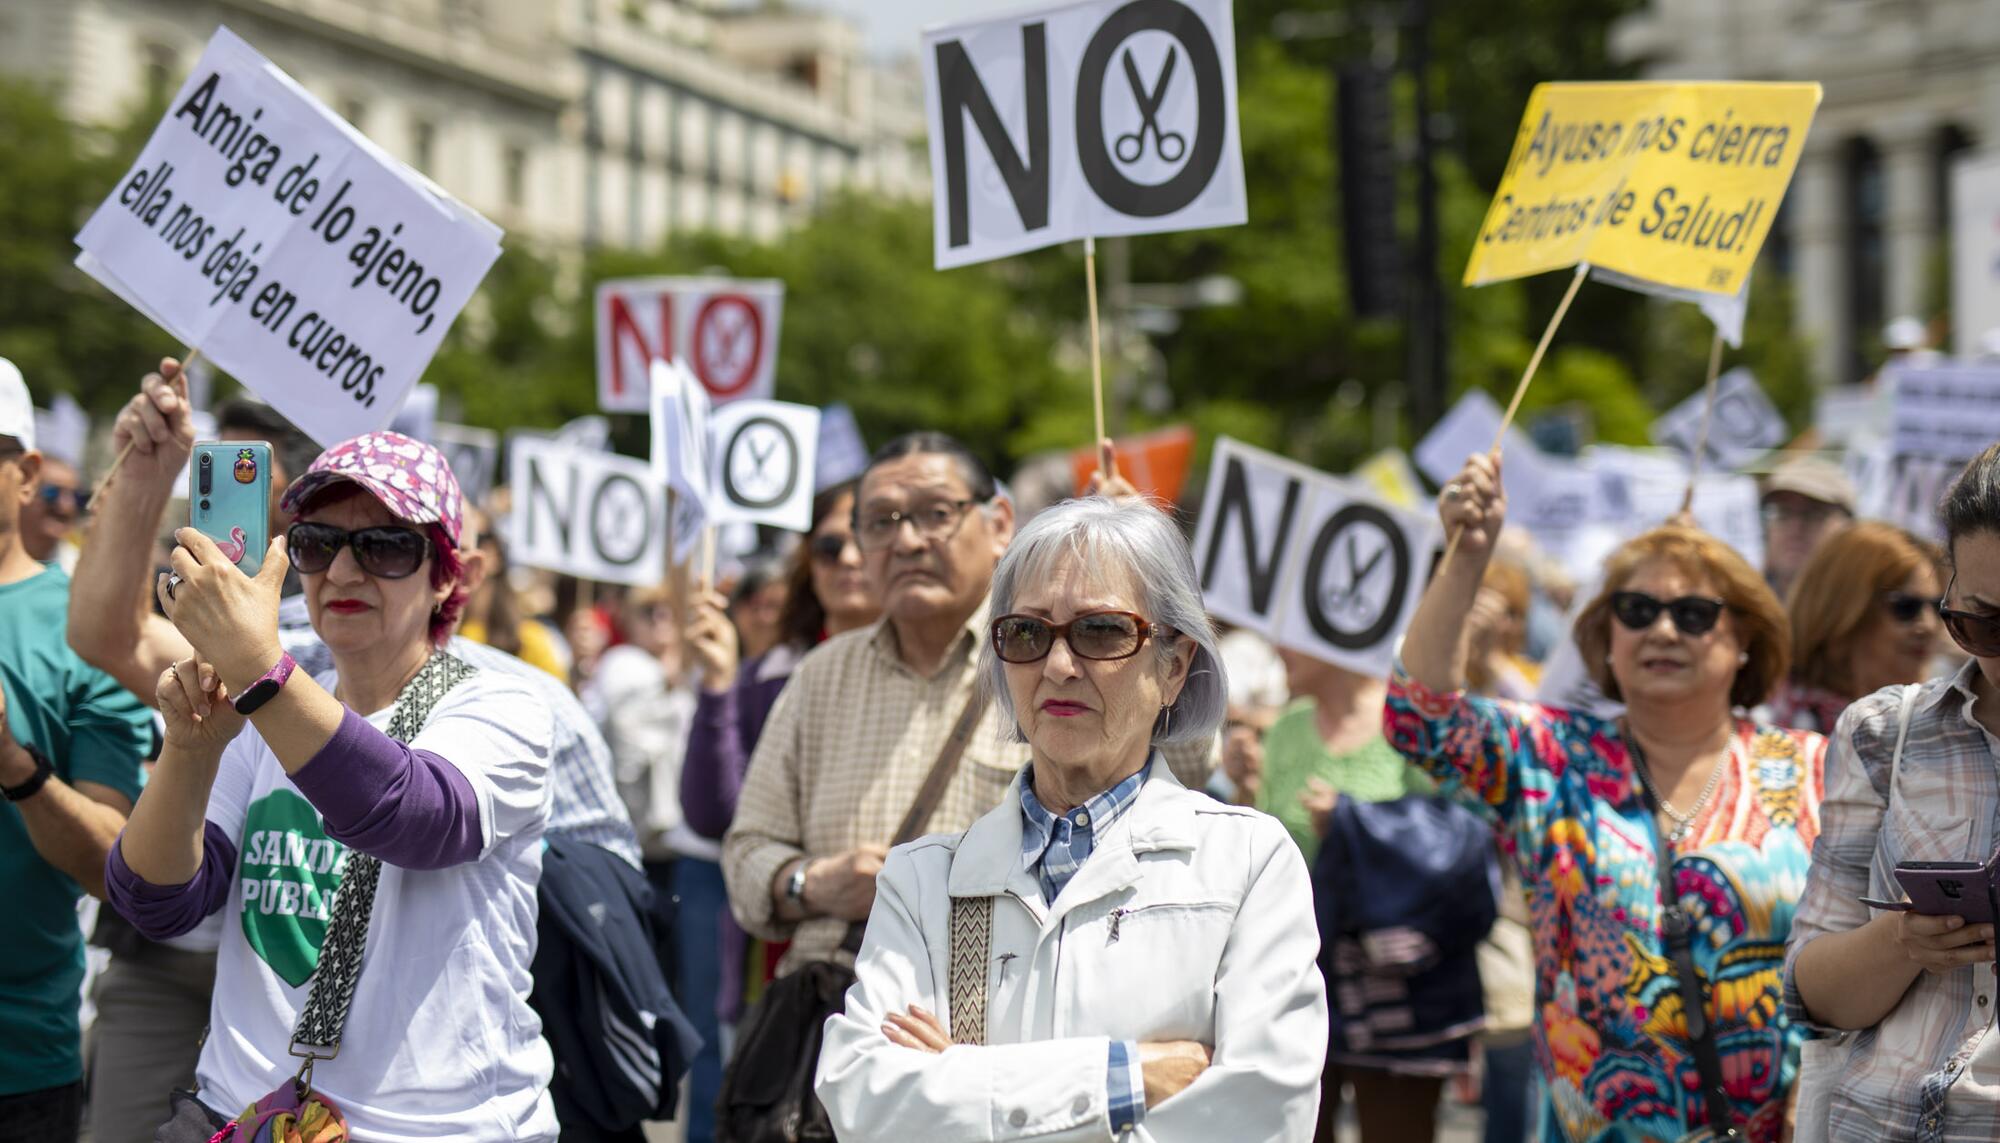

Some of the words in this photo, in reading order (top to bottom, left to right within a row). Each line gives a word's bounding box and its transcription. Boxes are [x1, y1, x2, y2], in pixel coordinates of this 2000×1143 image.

[935, 0, 1226, 250] NO
[1623, 116, 1686, 156] nos
[1689, 108, 1791, 168] cierra
[175, 72, 281, 187] Amiga
[273, 153, 319, 215] de
[311, 180, 355, 243] lo
[348, 222, 441, 335] ajeno,
[1483, 192, 1594, 244] Centros
[1594, 177, 1636, 226] de
[1639, 186, 1764, 255] Salud!
[119, 161, 174, 227] ella
[159, 203, 215, 260] nos
[201, 227, 262, 307] deja
[250, 281, 297, 332] en
[288, 311, 385, 409] cueros.
[609, 294, 763, 398] NO
[526, 455, 651, 566] NO
[1201, 456, 1411, 650] NO
